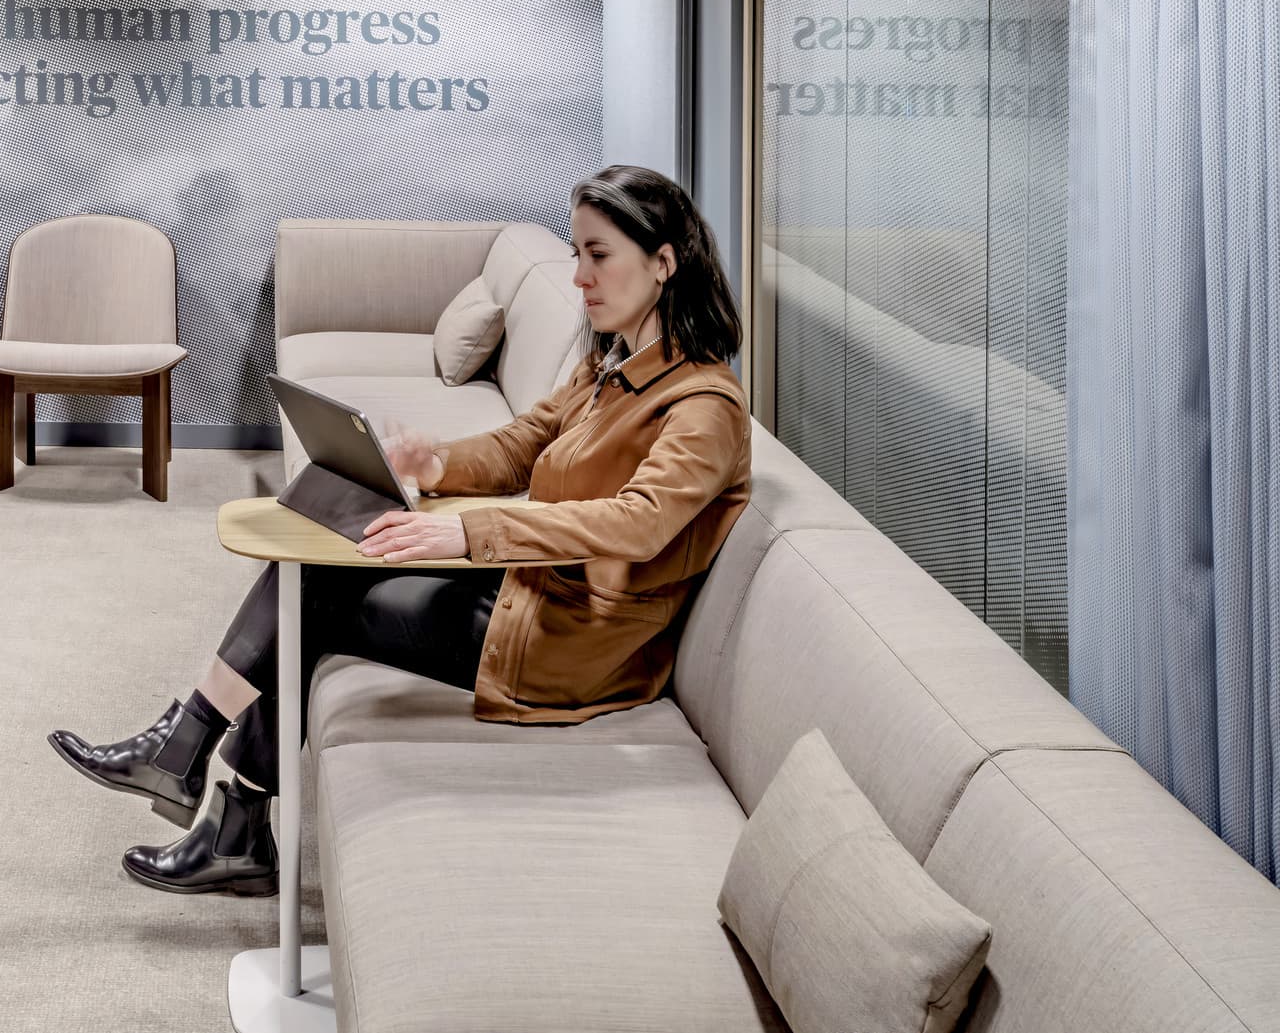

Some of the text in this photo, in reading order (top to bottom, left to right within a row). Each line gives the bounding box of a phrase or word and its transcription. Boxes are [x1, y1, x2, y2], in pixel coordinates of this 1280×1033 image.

[205, 1, 441, 55] progress
[133, 61, 267, 109] what
[280, 66, 490, 112] matters
